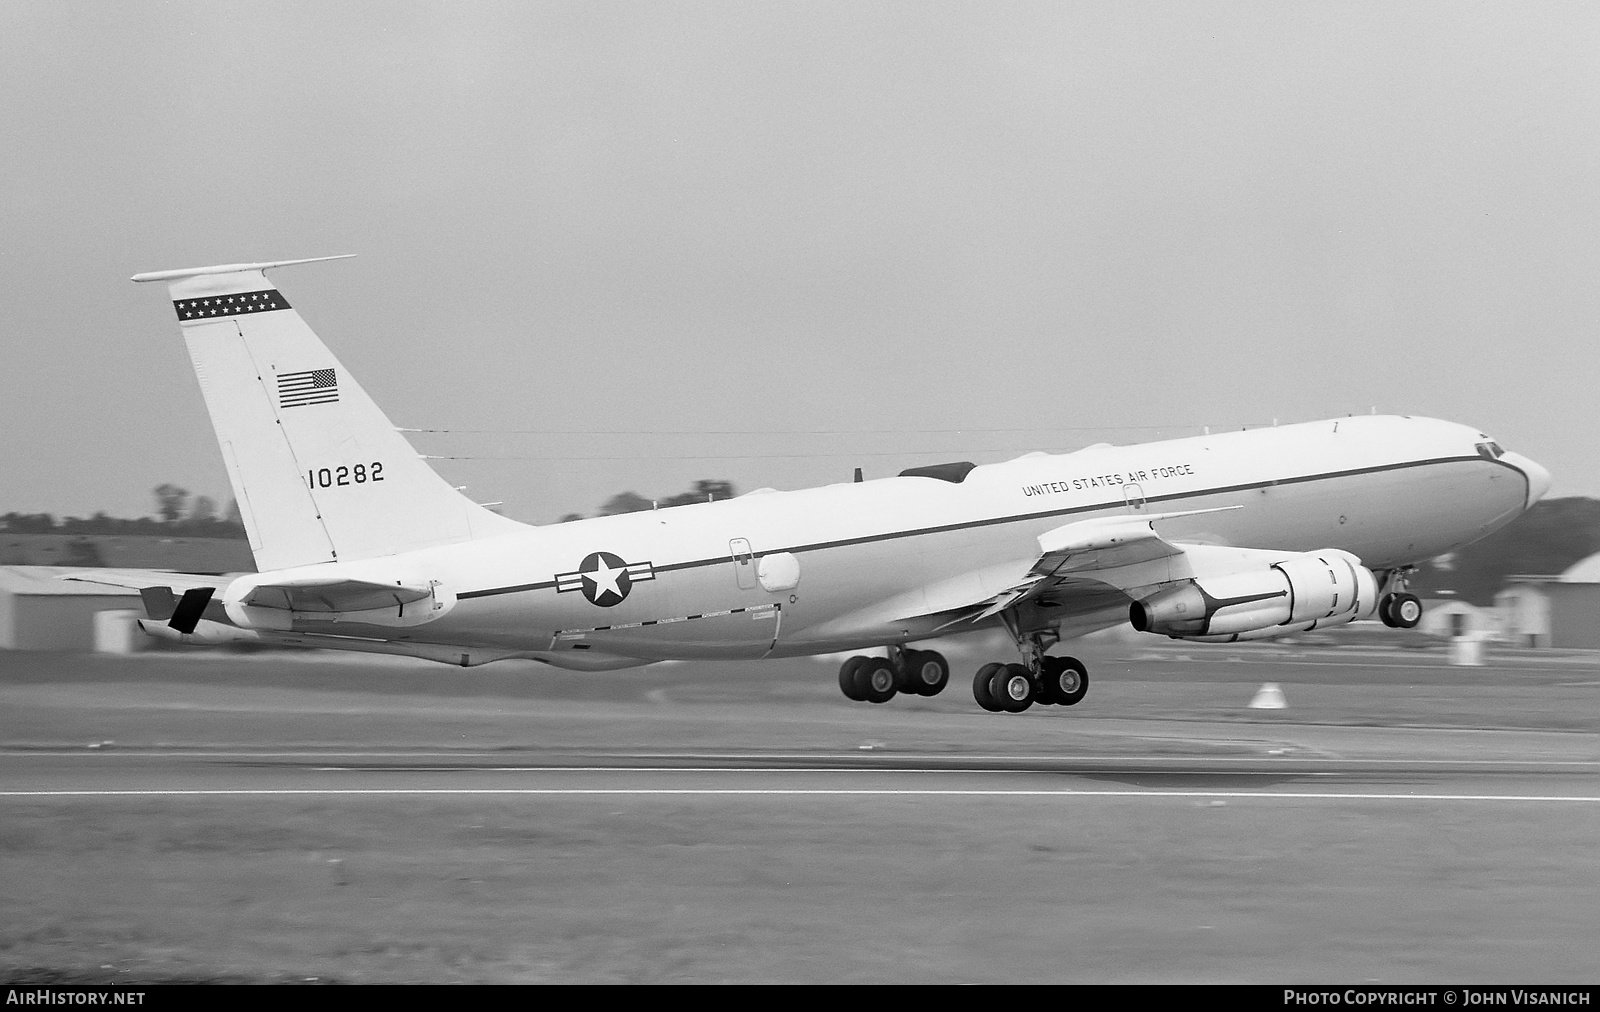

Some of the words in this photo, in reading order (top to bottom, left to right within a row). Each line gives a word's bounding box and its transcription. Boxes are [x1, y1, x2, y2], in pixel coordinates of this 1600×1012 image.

[308, 461, 384, 489] 10282
[1022, 481, 1070, 497] UNITED
[1073, 474, 1124, 490] STATES
[1128, 470, 1148, 483] AIR
[1151, 464, 1194, 480] FORCE
